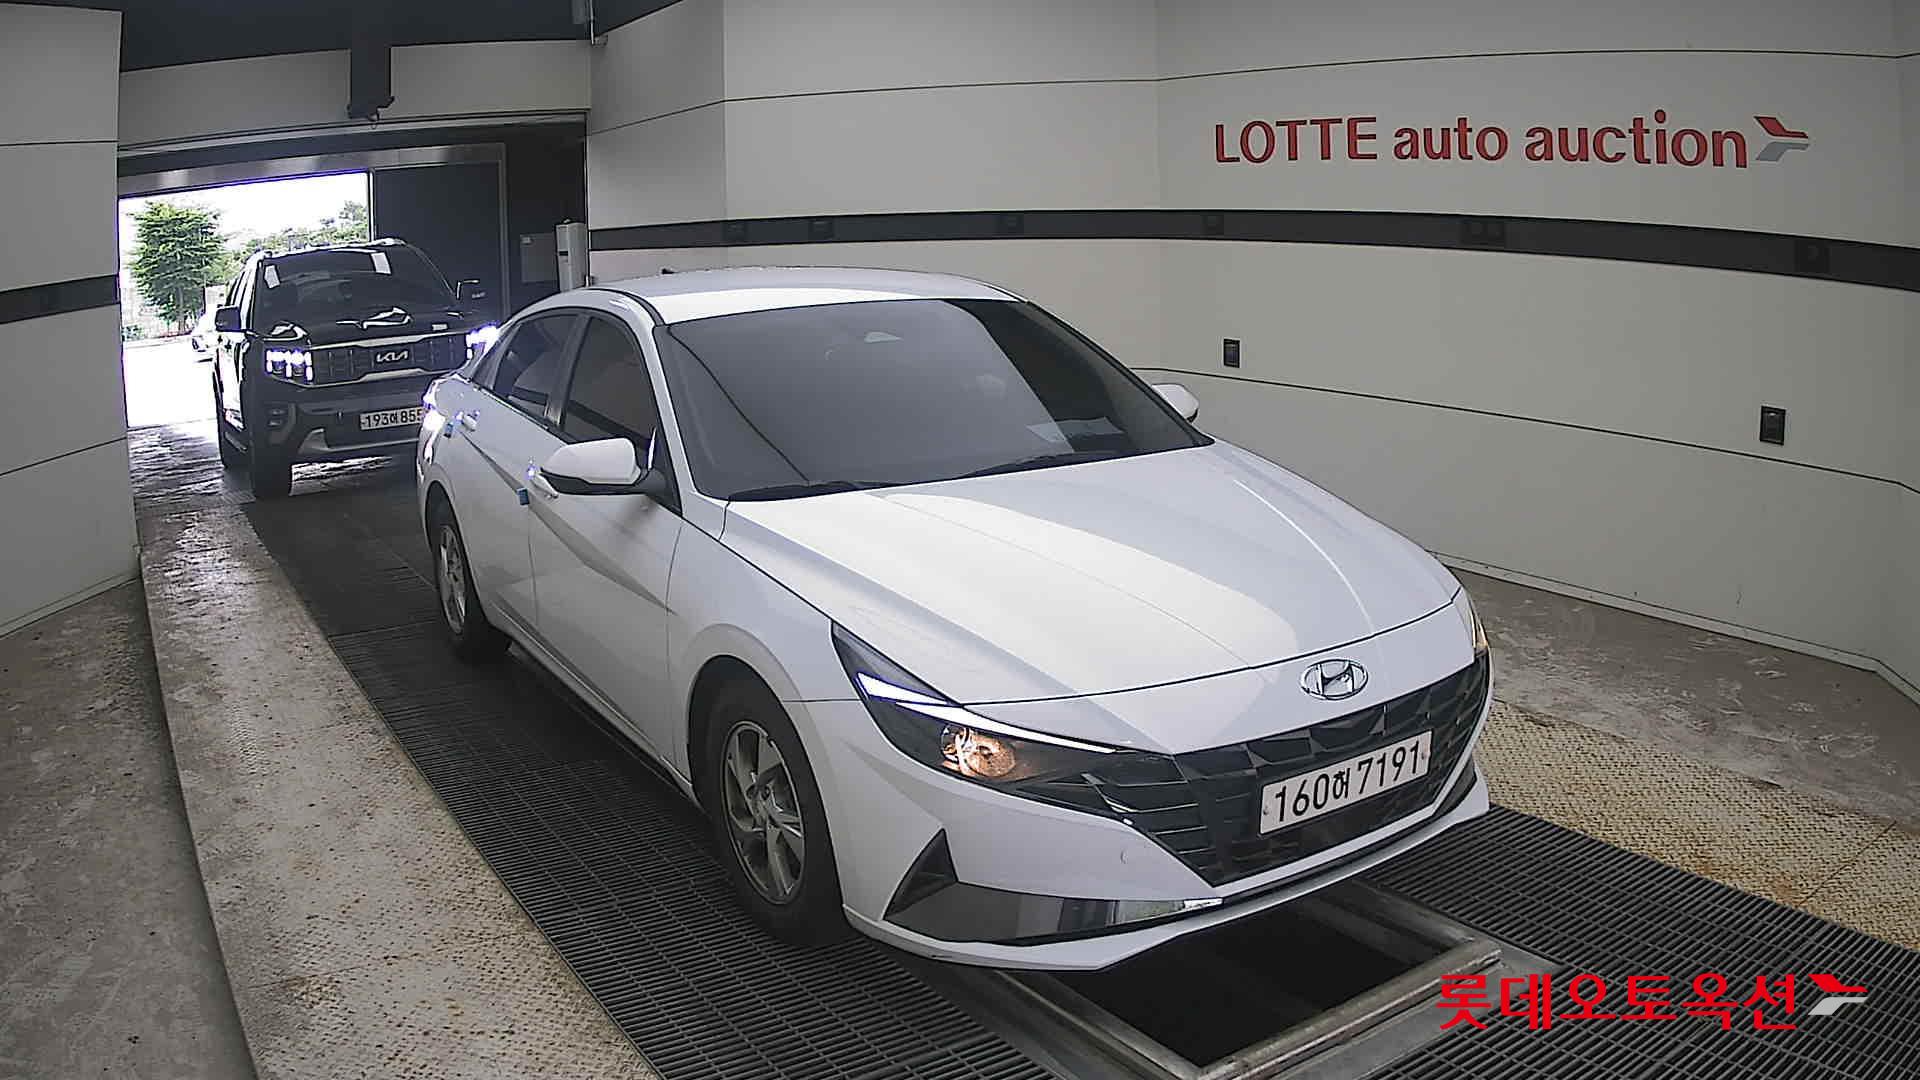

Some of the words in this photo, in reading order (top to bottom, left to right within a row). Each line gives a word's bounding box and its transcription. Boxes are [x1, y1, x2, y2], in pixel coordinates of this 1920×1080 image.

[1215, 116, 1377, 164] LOTTE
[1393, 116, 1508, 162] auto
[1524, 110, 1749, 168] auction
[1275, 768, 1351, 822] 160허
[1358, 740, 1420, 795] 7191
